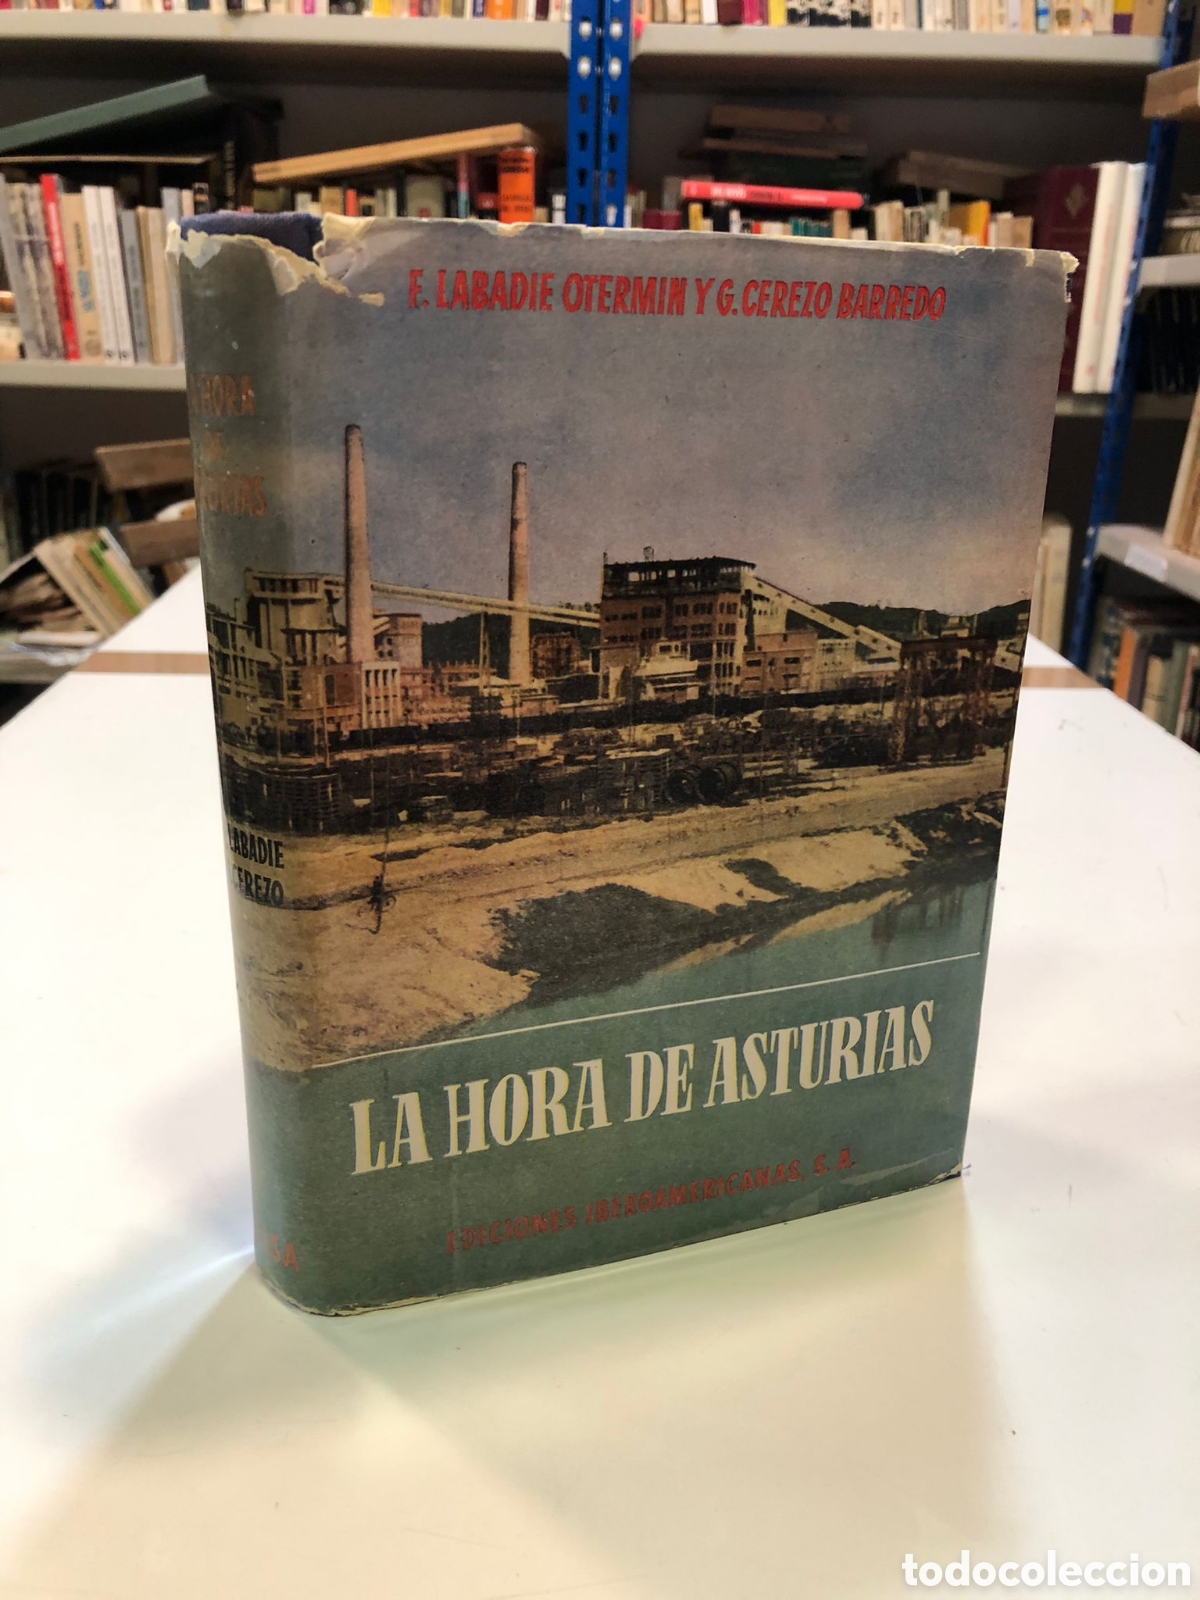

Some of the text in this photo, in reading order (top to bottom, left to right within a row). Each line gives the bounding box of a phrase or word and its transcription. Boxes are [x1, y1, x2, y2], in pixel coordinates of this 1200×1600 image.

[437, 269, 554, 312] LABADIE
[562, 273, 686, 316] OTERMIN
[695, 278, 717, 316] Y
[741, 280, 832, 320] CEREZO
[838, 284, 946, 322] BARREDO
[227, 823, 285, 869] LABADIE
[351, 999, 934, 1175] LA HORA DE ASTURIAS
[446, 1207, 577, 1254] EDICIONES
[813, 1154, 830, 1176] S.
[835, 1148, 857, 1172] A.
